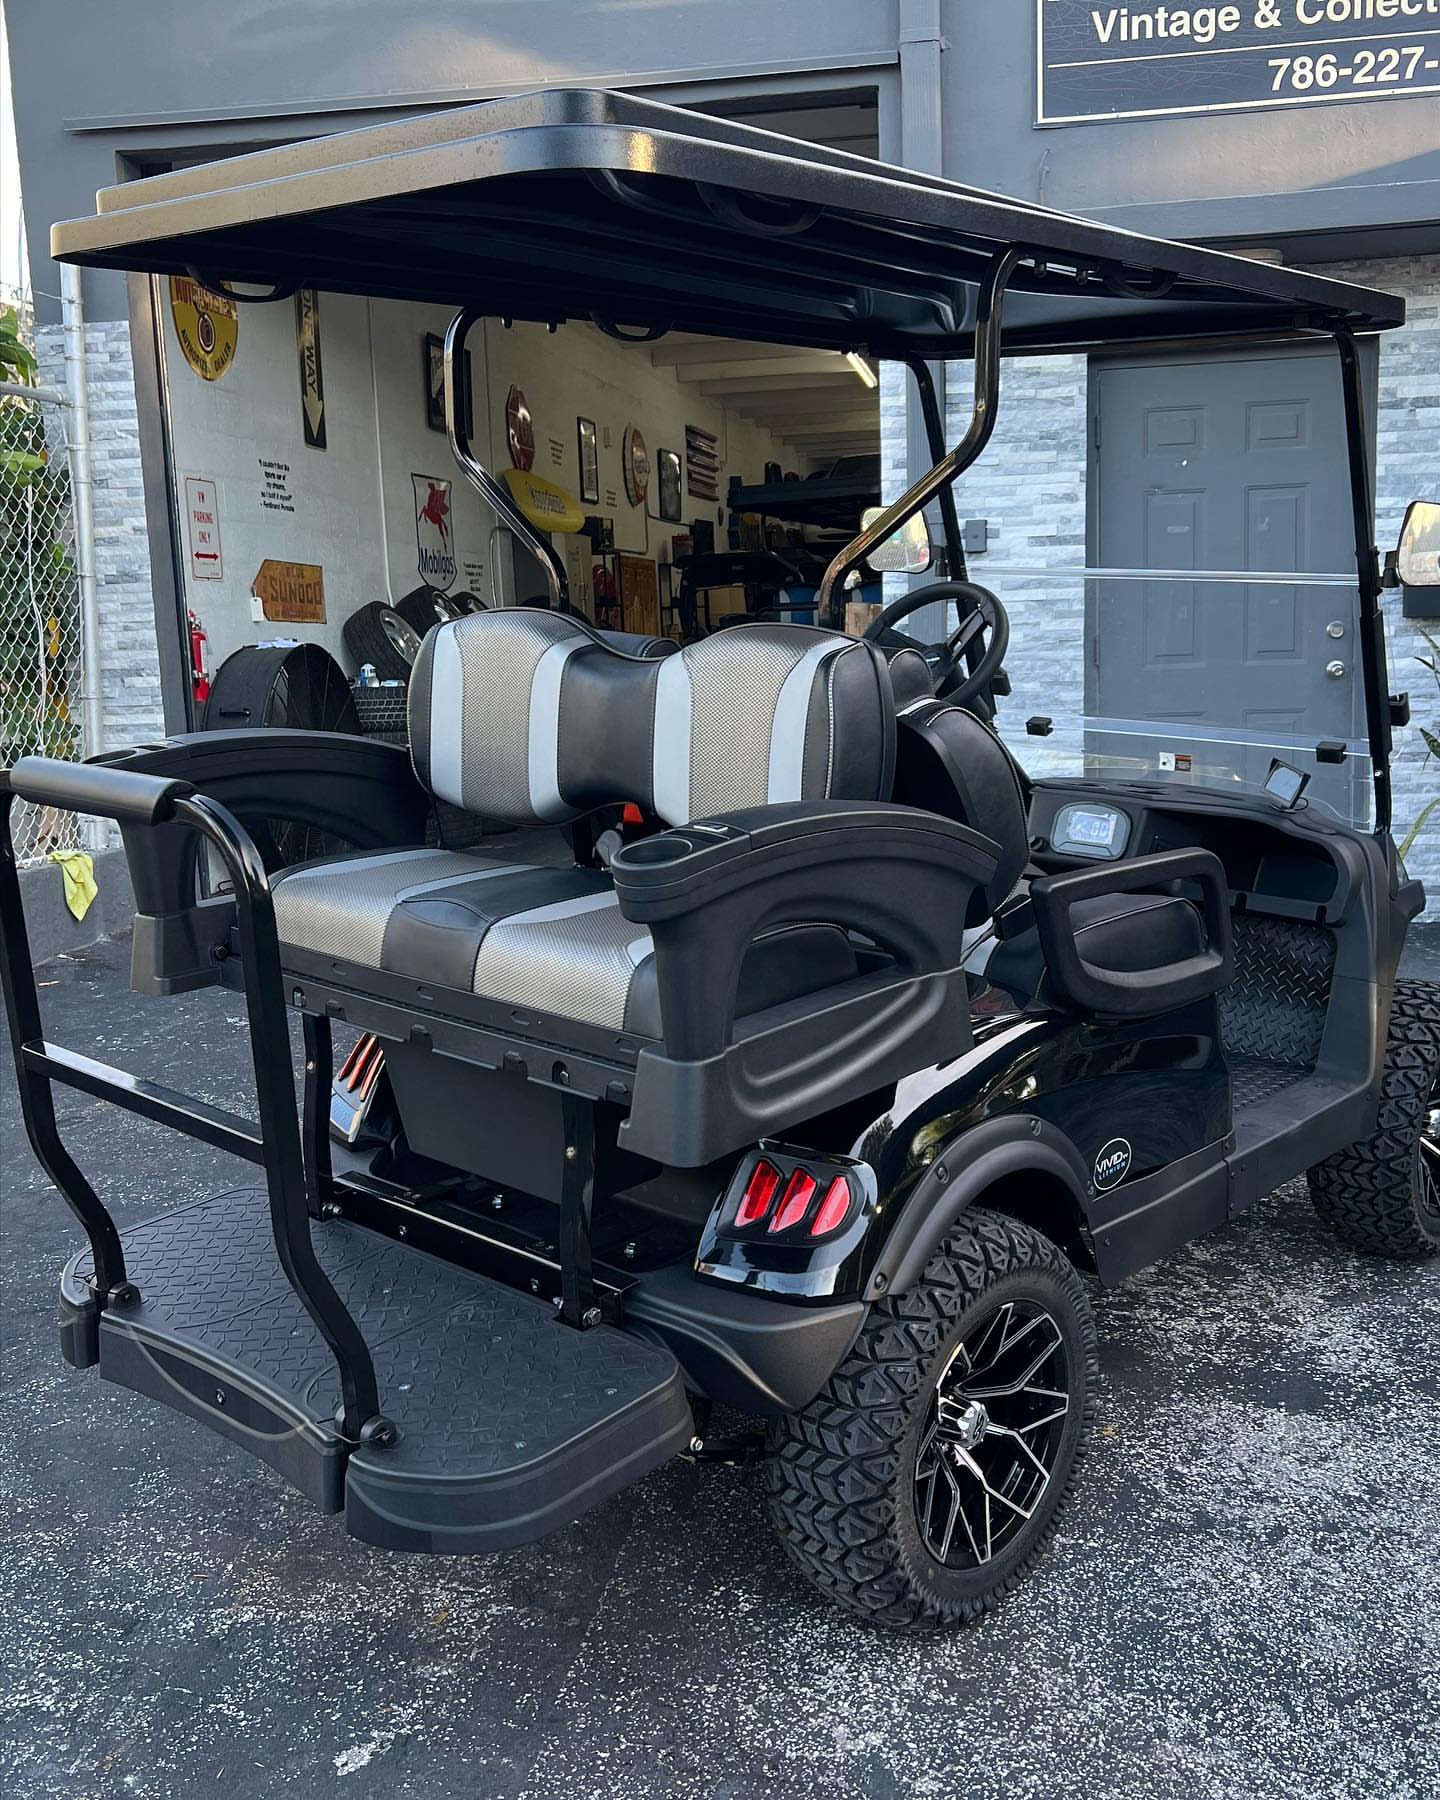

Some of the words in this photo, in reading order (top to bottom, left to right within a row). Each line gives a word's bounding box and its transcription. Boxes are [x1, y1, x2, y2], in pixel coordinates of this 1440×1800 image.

[1092, 5, 1240, 43] Vintage
[1255, 0, 1282, 29] &
[1268, 46, 1439, 91] 786-227-
[305, 344, 317, 393] WAY
[420, 547, 454, 581] Mobilgas
[270, 576, 323, 605] SUNOCO
[1096, 1151, 1123, 1173] VIVID
